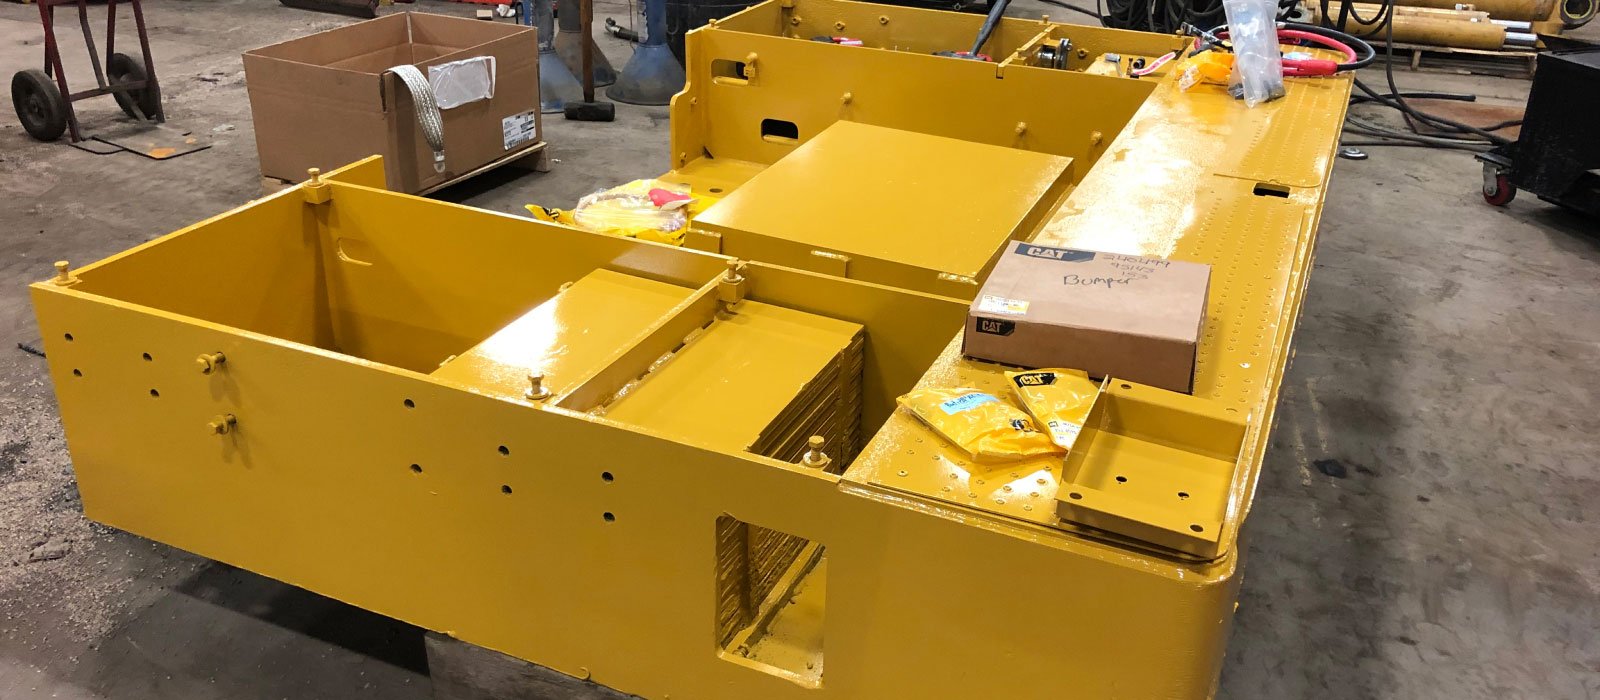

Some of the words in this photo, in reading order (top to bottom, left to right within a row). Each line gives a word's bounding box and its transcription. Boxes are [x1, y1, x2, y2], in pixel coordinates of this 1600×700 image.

[1026, 247, 1069, 259] CAT
[1063, 274, 1132, 288] Bumper
[982, 320, 1002, 333] CAT
[1020, 374, 1044, 385] CAT
